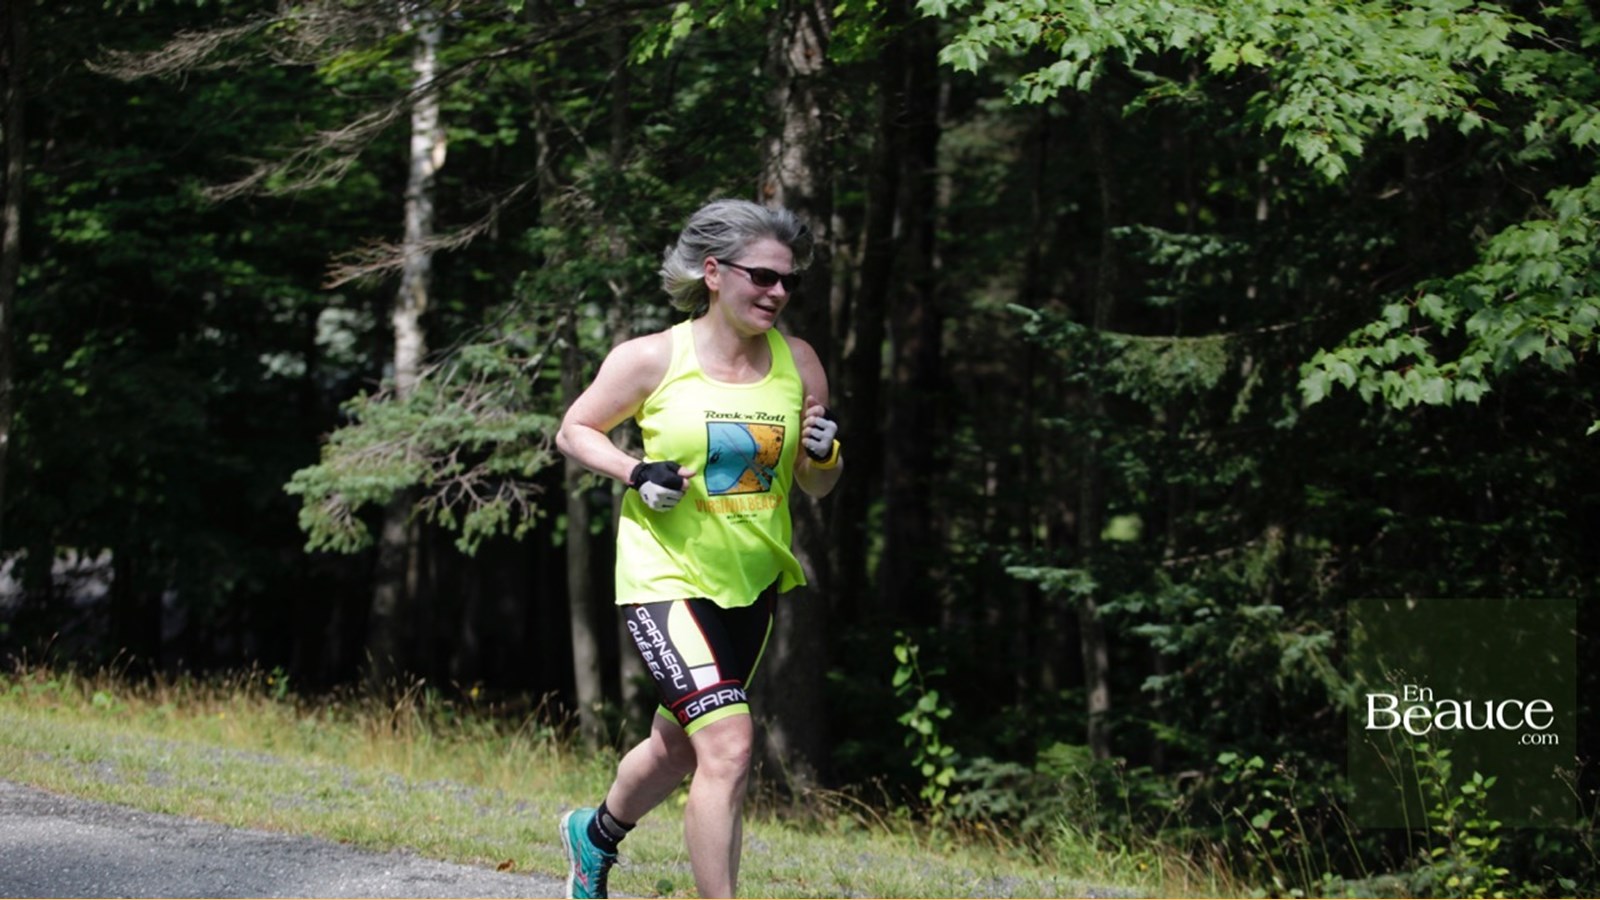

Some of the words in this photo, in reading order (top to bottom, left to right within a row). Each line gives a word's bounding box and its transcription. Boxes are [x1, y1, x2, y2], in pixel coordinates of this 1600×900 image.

[704, 410, 742, 419] Rock
[755, 411, 786, 422] Roll
[695, 497, 747, 514] VIRGINIA
[627, 619, 665, 681] QUÉBEC
[635, 606, 687, 690] GARNEAU
